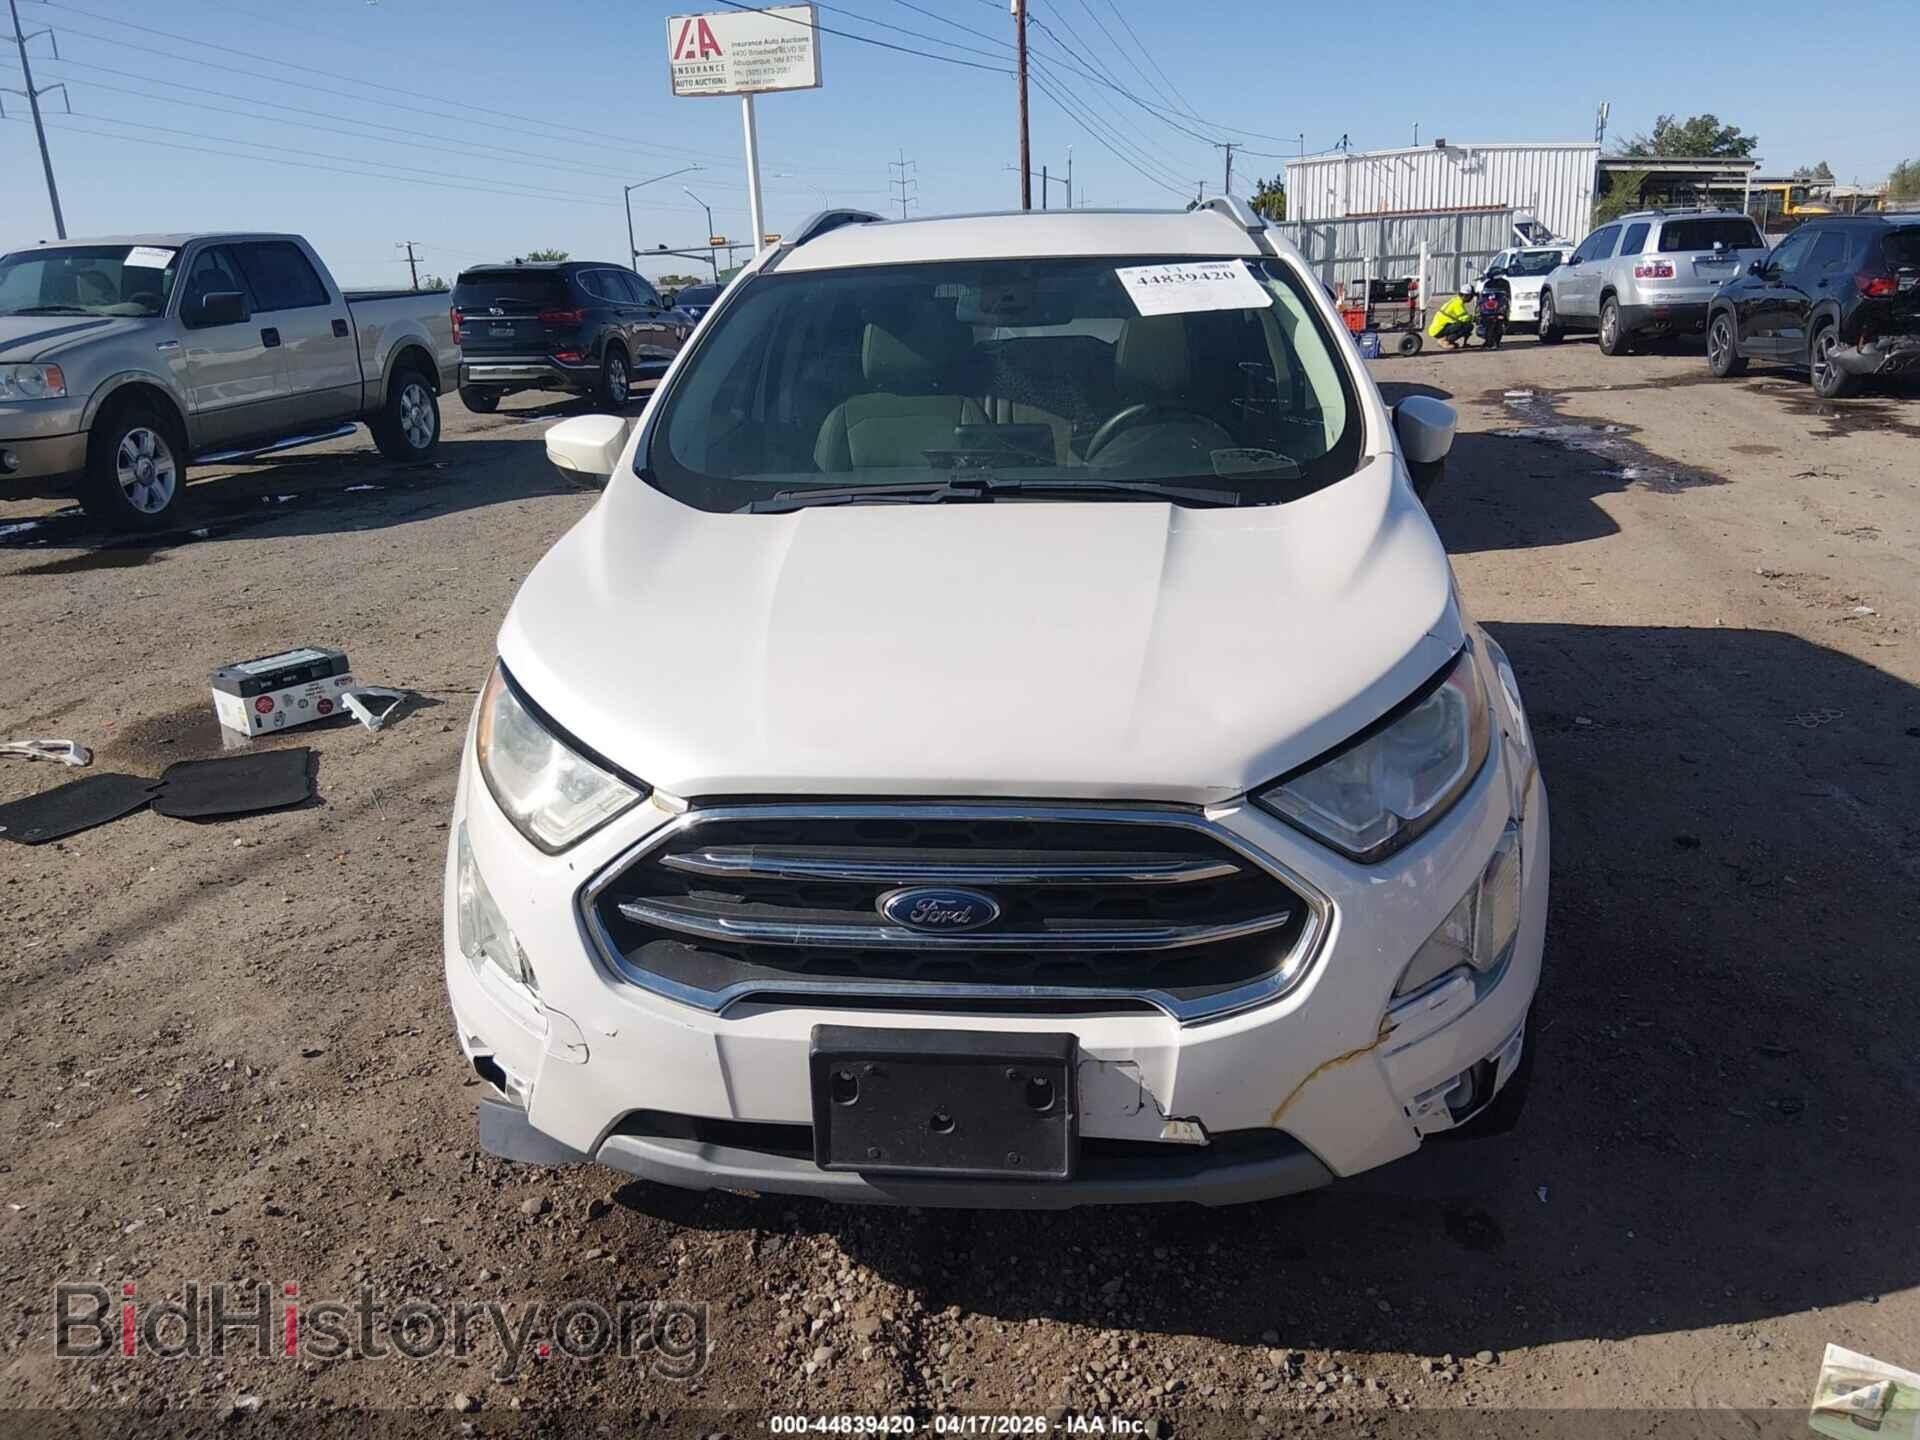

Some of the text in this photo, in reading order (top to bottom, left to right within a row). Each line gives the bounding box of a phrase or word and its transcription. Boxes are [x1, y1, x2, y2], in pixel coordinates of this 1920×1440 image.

[764, 37, 779, 45] Auto
[773, 56, 785, 64] NM
[674, 64, 726, 75] INSURANCE
[676, 77, 727, 87] AUTO AUCTIONS
[1137, 271, 1235, 285] 44839420
[911, 898, 972, 923] Ford
